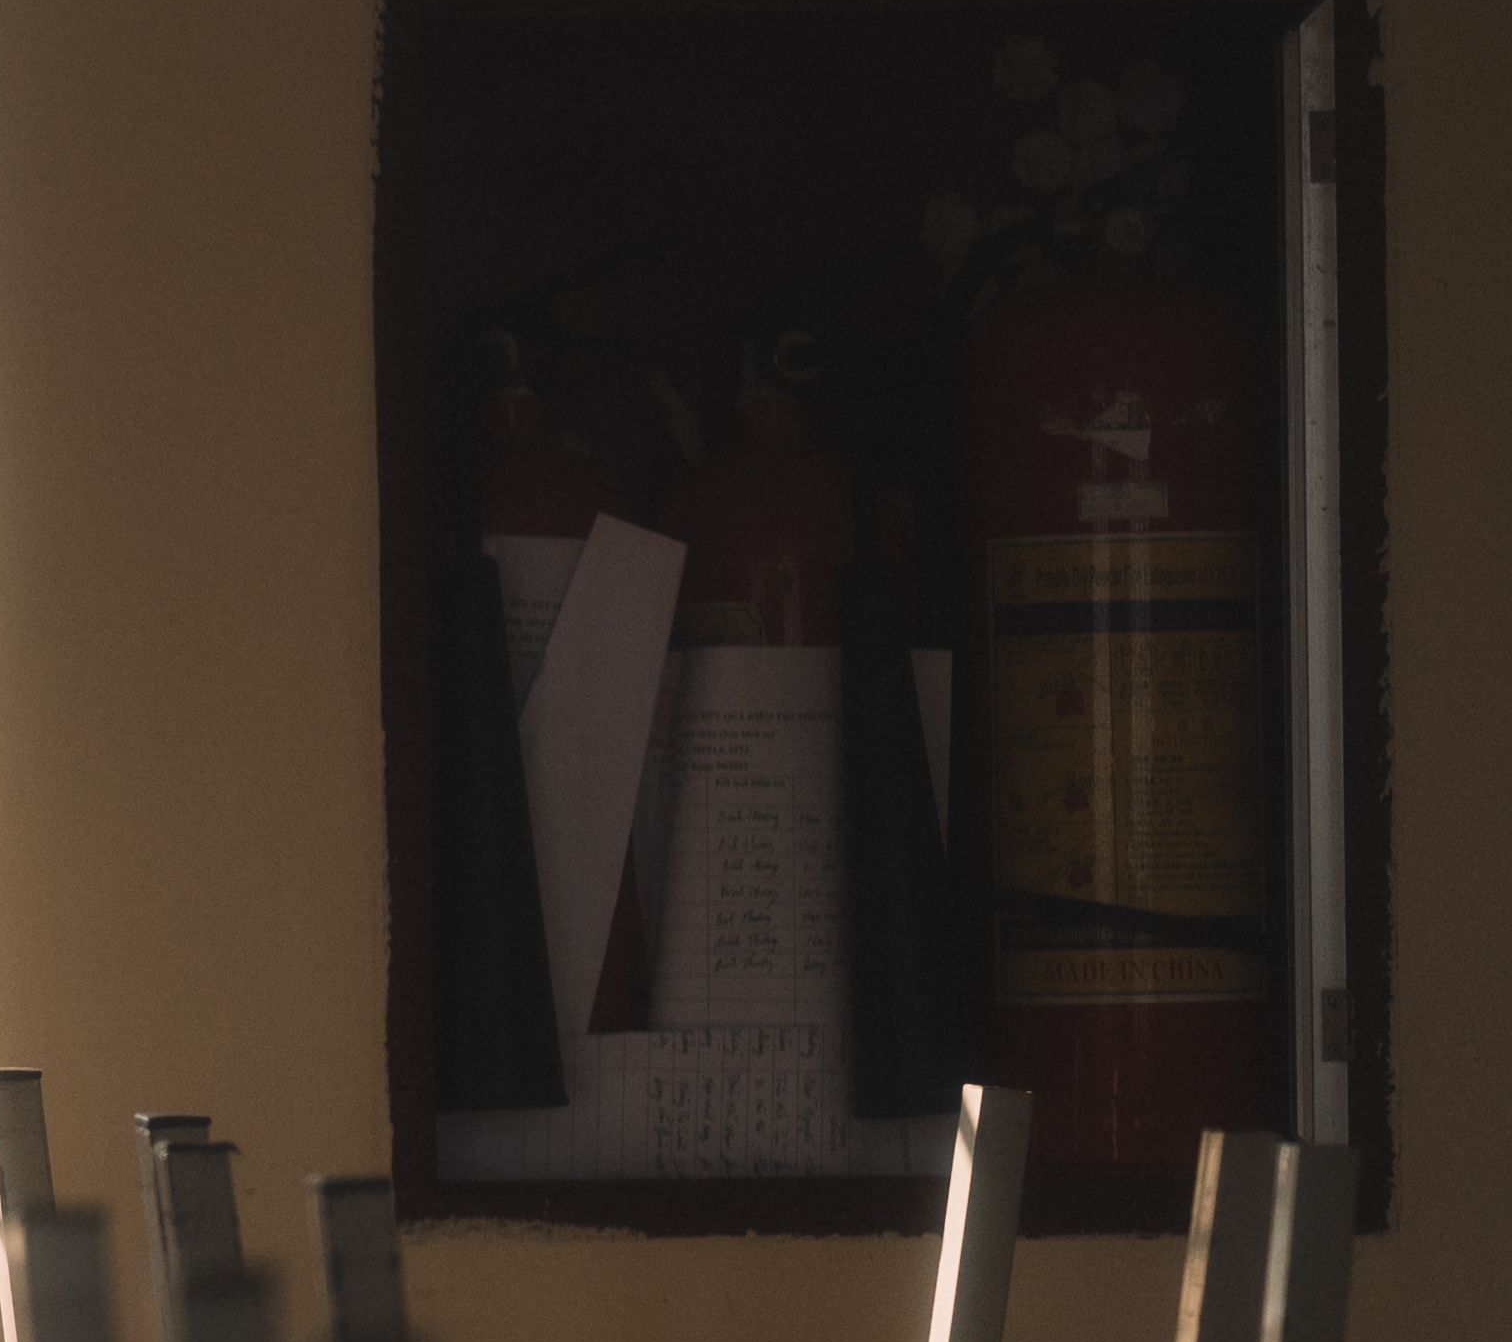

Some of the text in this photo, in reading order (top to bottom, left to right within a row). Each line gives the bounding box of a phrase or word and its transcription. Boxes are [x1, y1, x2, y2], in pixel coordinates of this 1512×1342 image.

[1046, 959, 1224, 982] MADE IN CHINA
